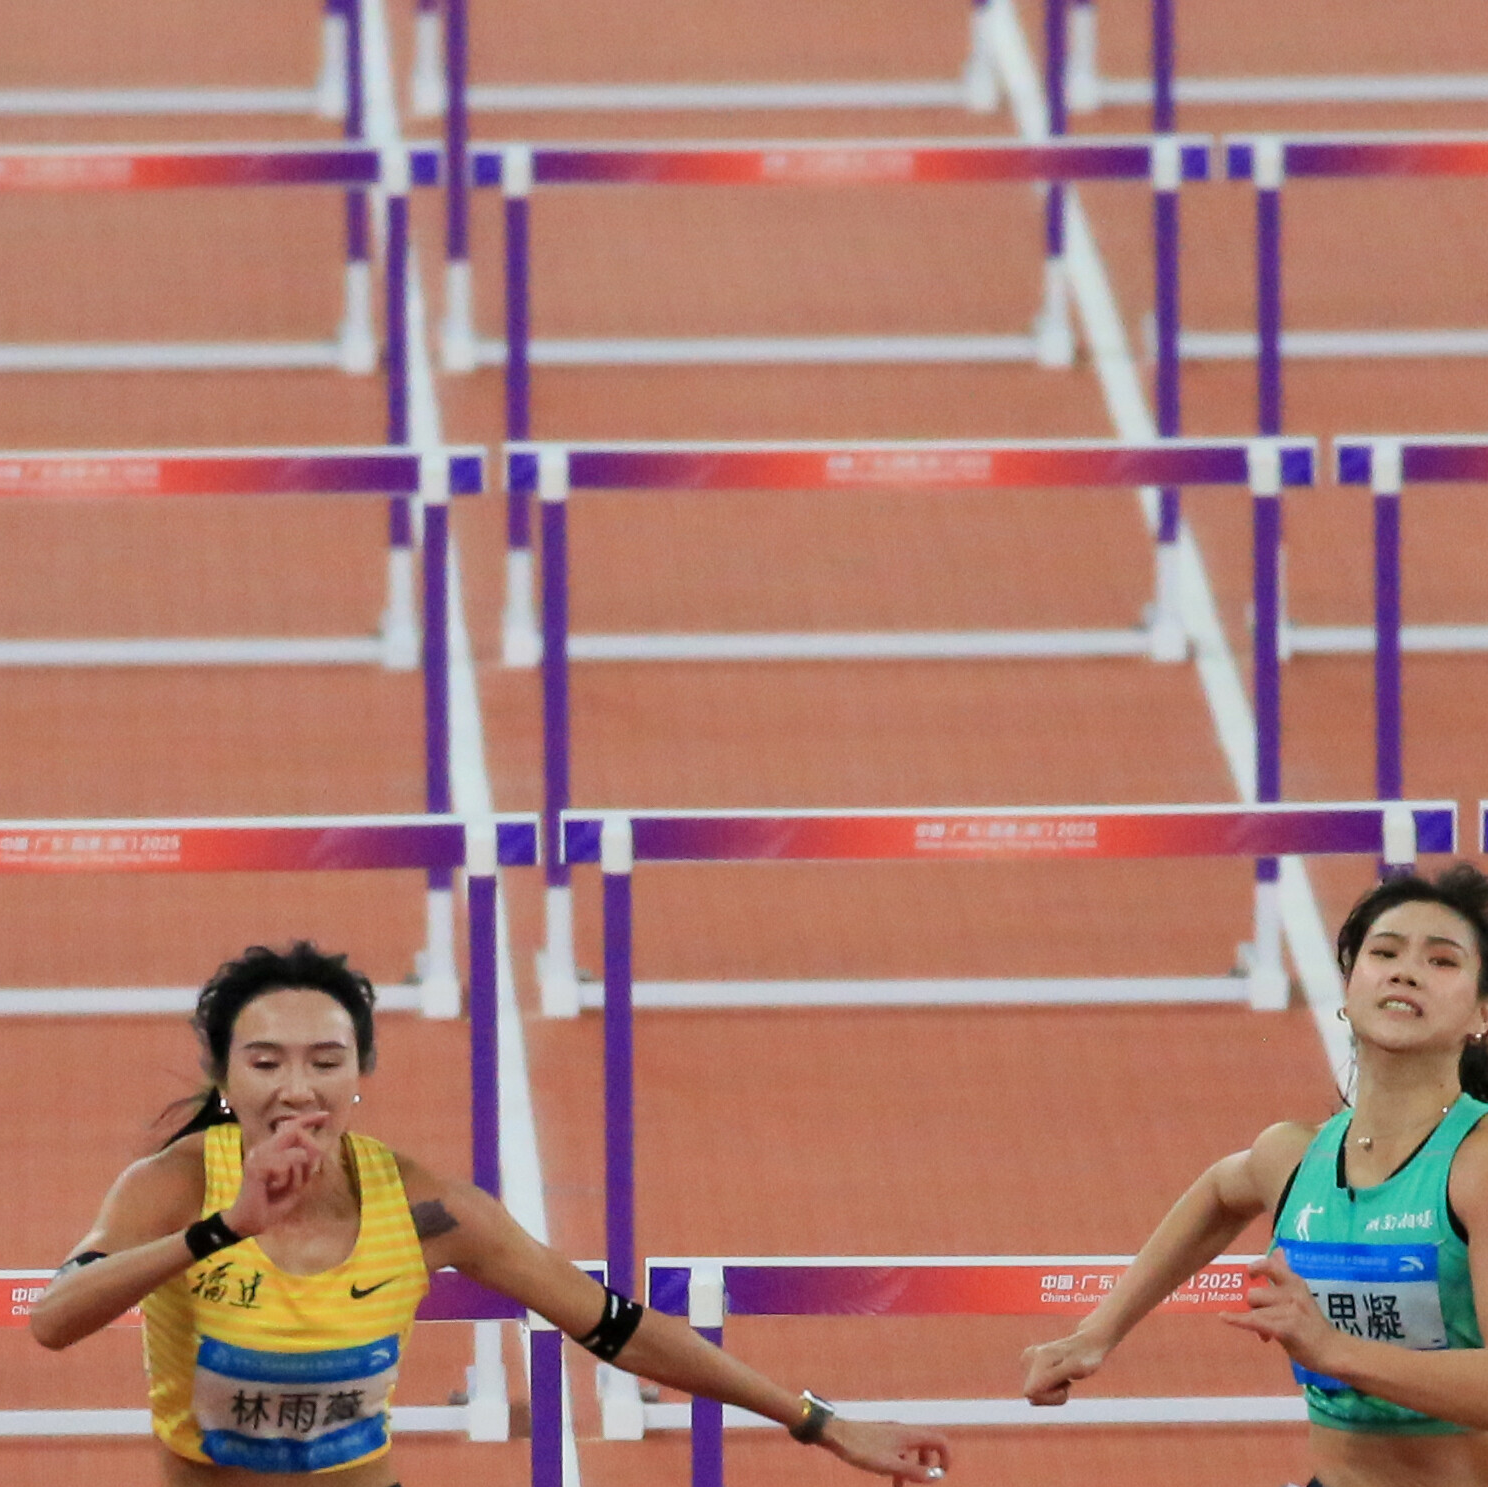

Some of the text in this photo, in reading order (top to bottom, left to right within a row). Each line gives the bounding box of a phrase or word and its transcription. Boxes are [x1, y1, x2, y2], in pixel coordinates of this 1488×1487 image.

[190, 1258, 266, 1310] 福建
[1310, 1291, 1407, 1341] 思凝
[231, 1387, 368, 1433] 林雨薇
